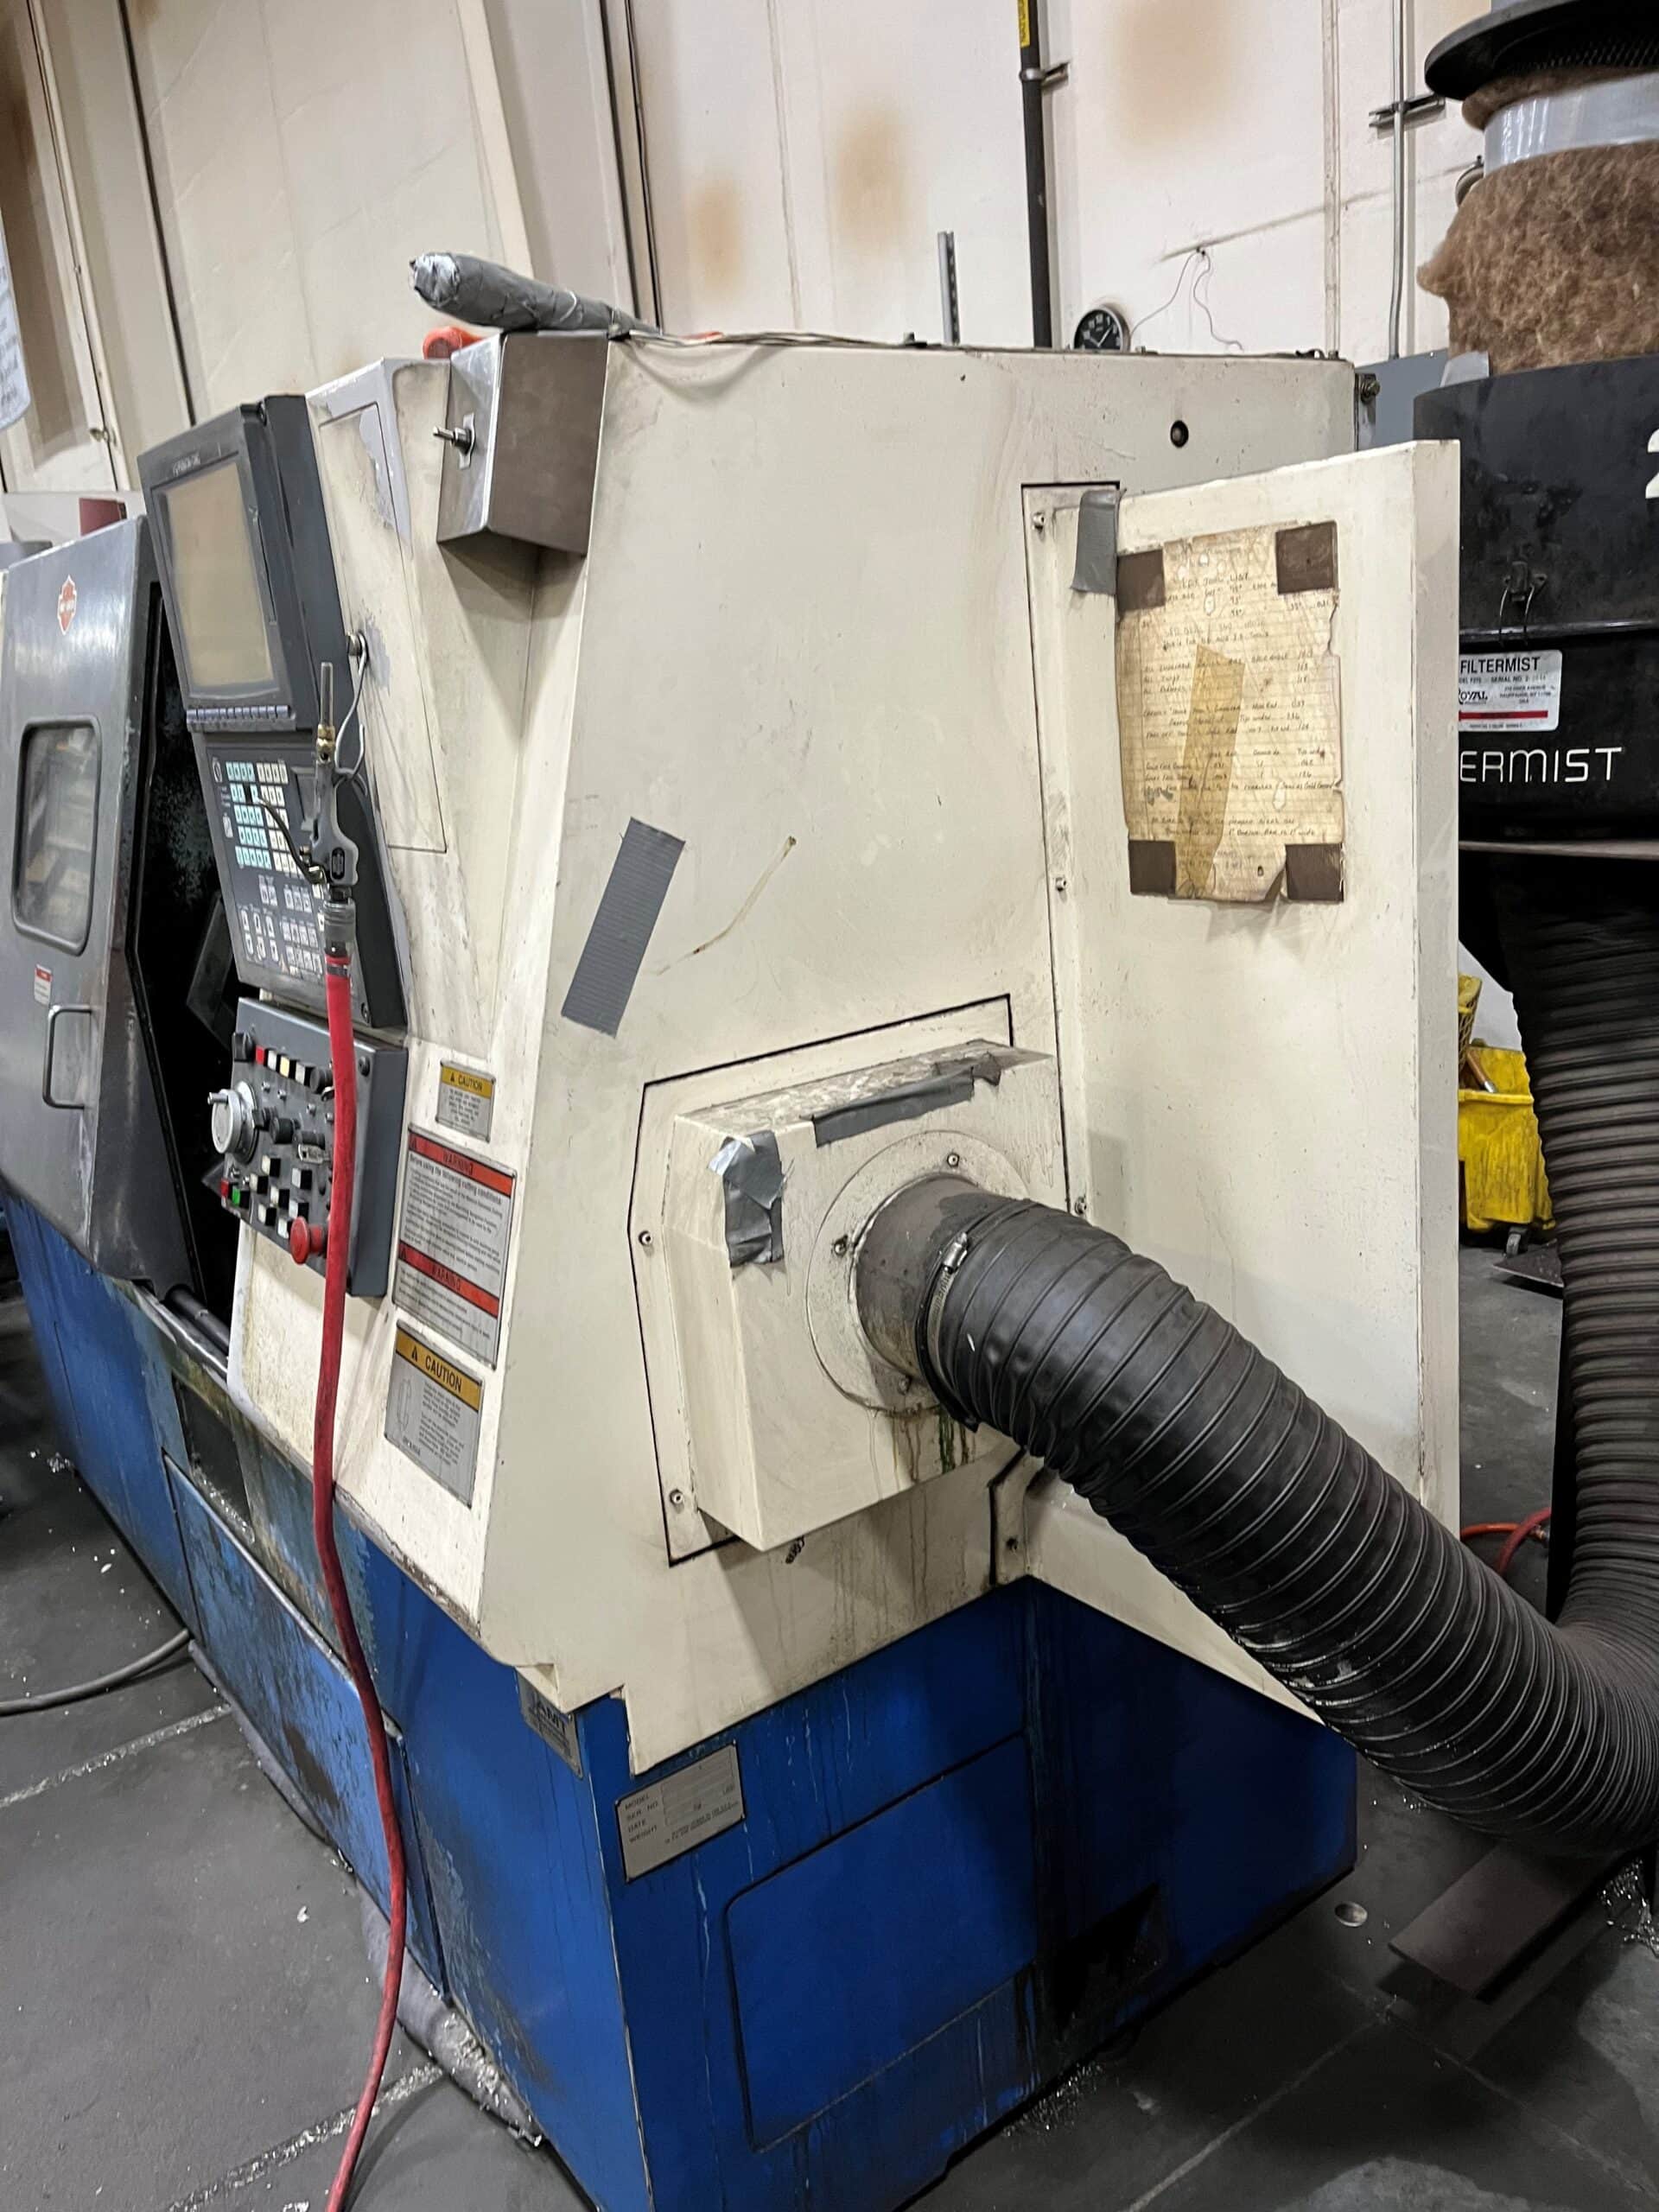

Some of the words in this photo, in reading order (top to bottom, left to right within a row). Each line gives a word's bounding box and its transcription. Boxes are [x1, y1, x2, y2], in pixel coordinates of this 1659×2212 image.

[1460, 657, 1541, 674] FILTERMIST
[1459, 747, 1623, 784] ERMIST
[457, 1074, 483, 1093] CAUTION
[425, 1356, 462, 1393] CAUTION
